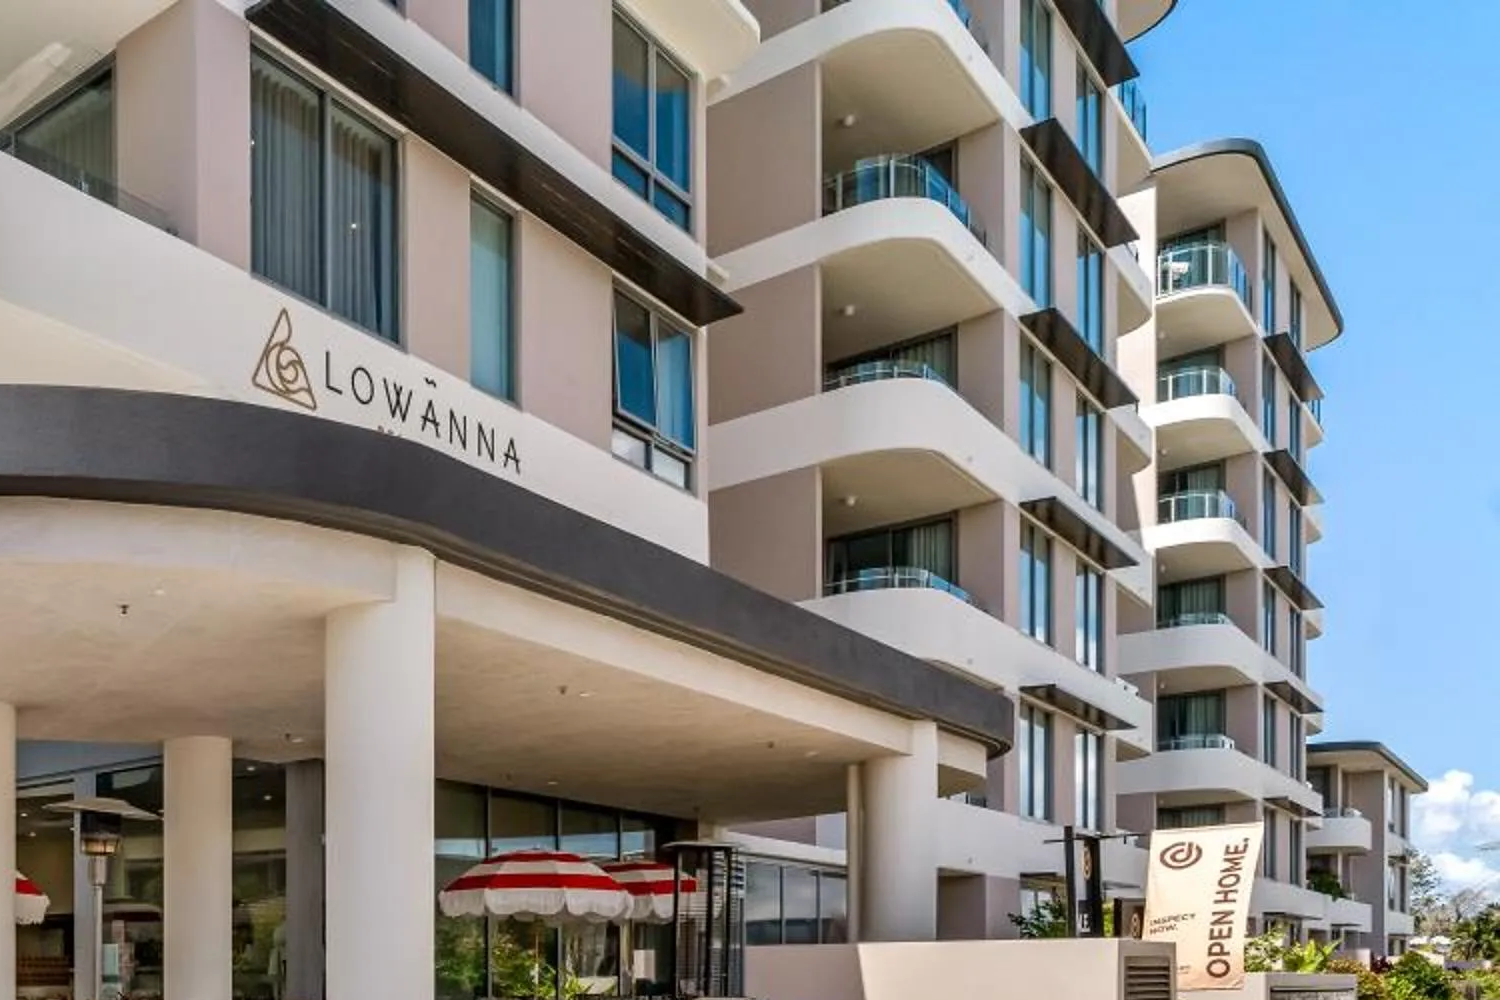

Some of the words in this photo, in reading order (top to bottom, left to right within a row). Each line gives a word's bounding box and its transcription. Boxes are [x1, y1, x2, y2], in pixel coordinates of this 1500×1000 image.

[1213, 837, 1250, 905] HOME.
[1149, 913, 1196, 926] INSPECT
[1205, 909, 1235, 979] OPEN
